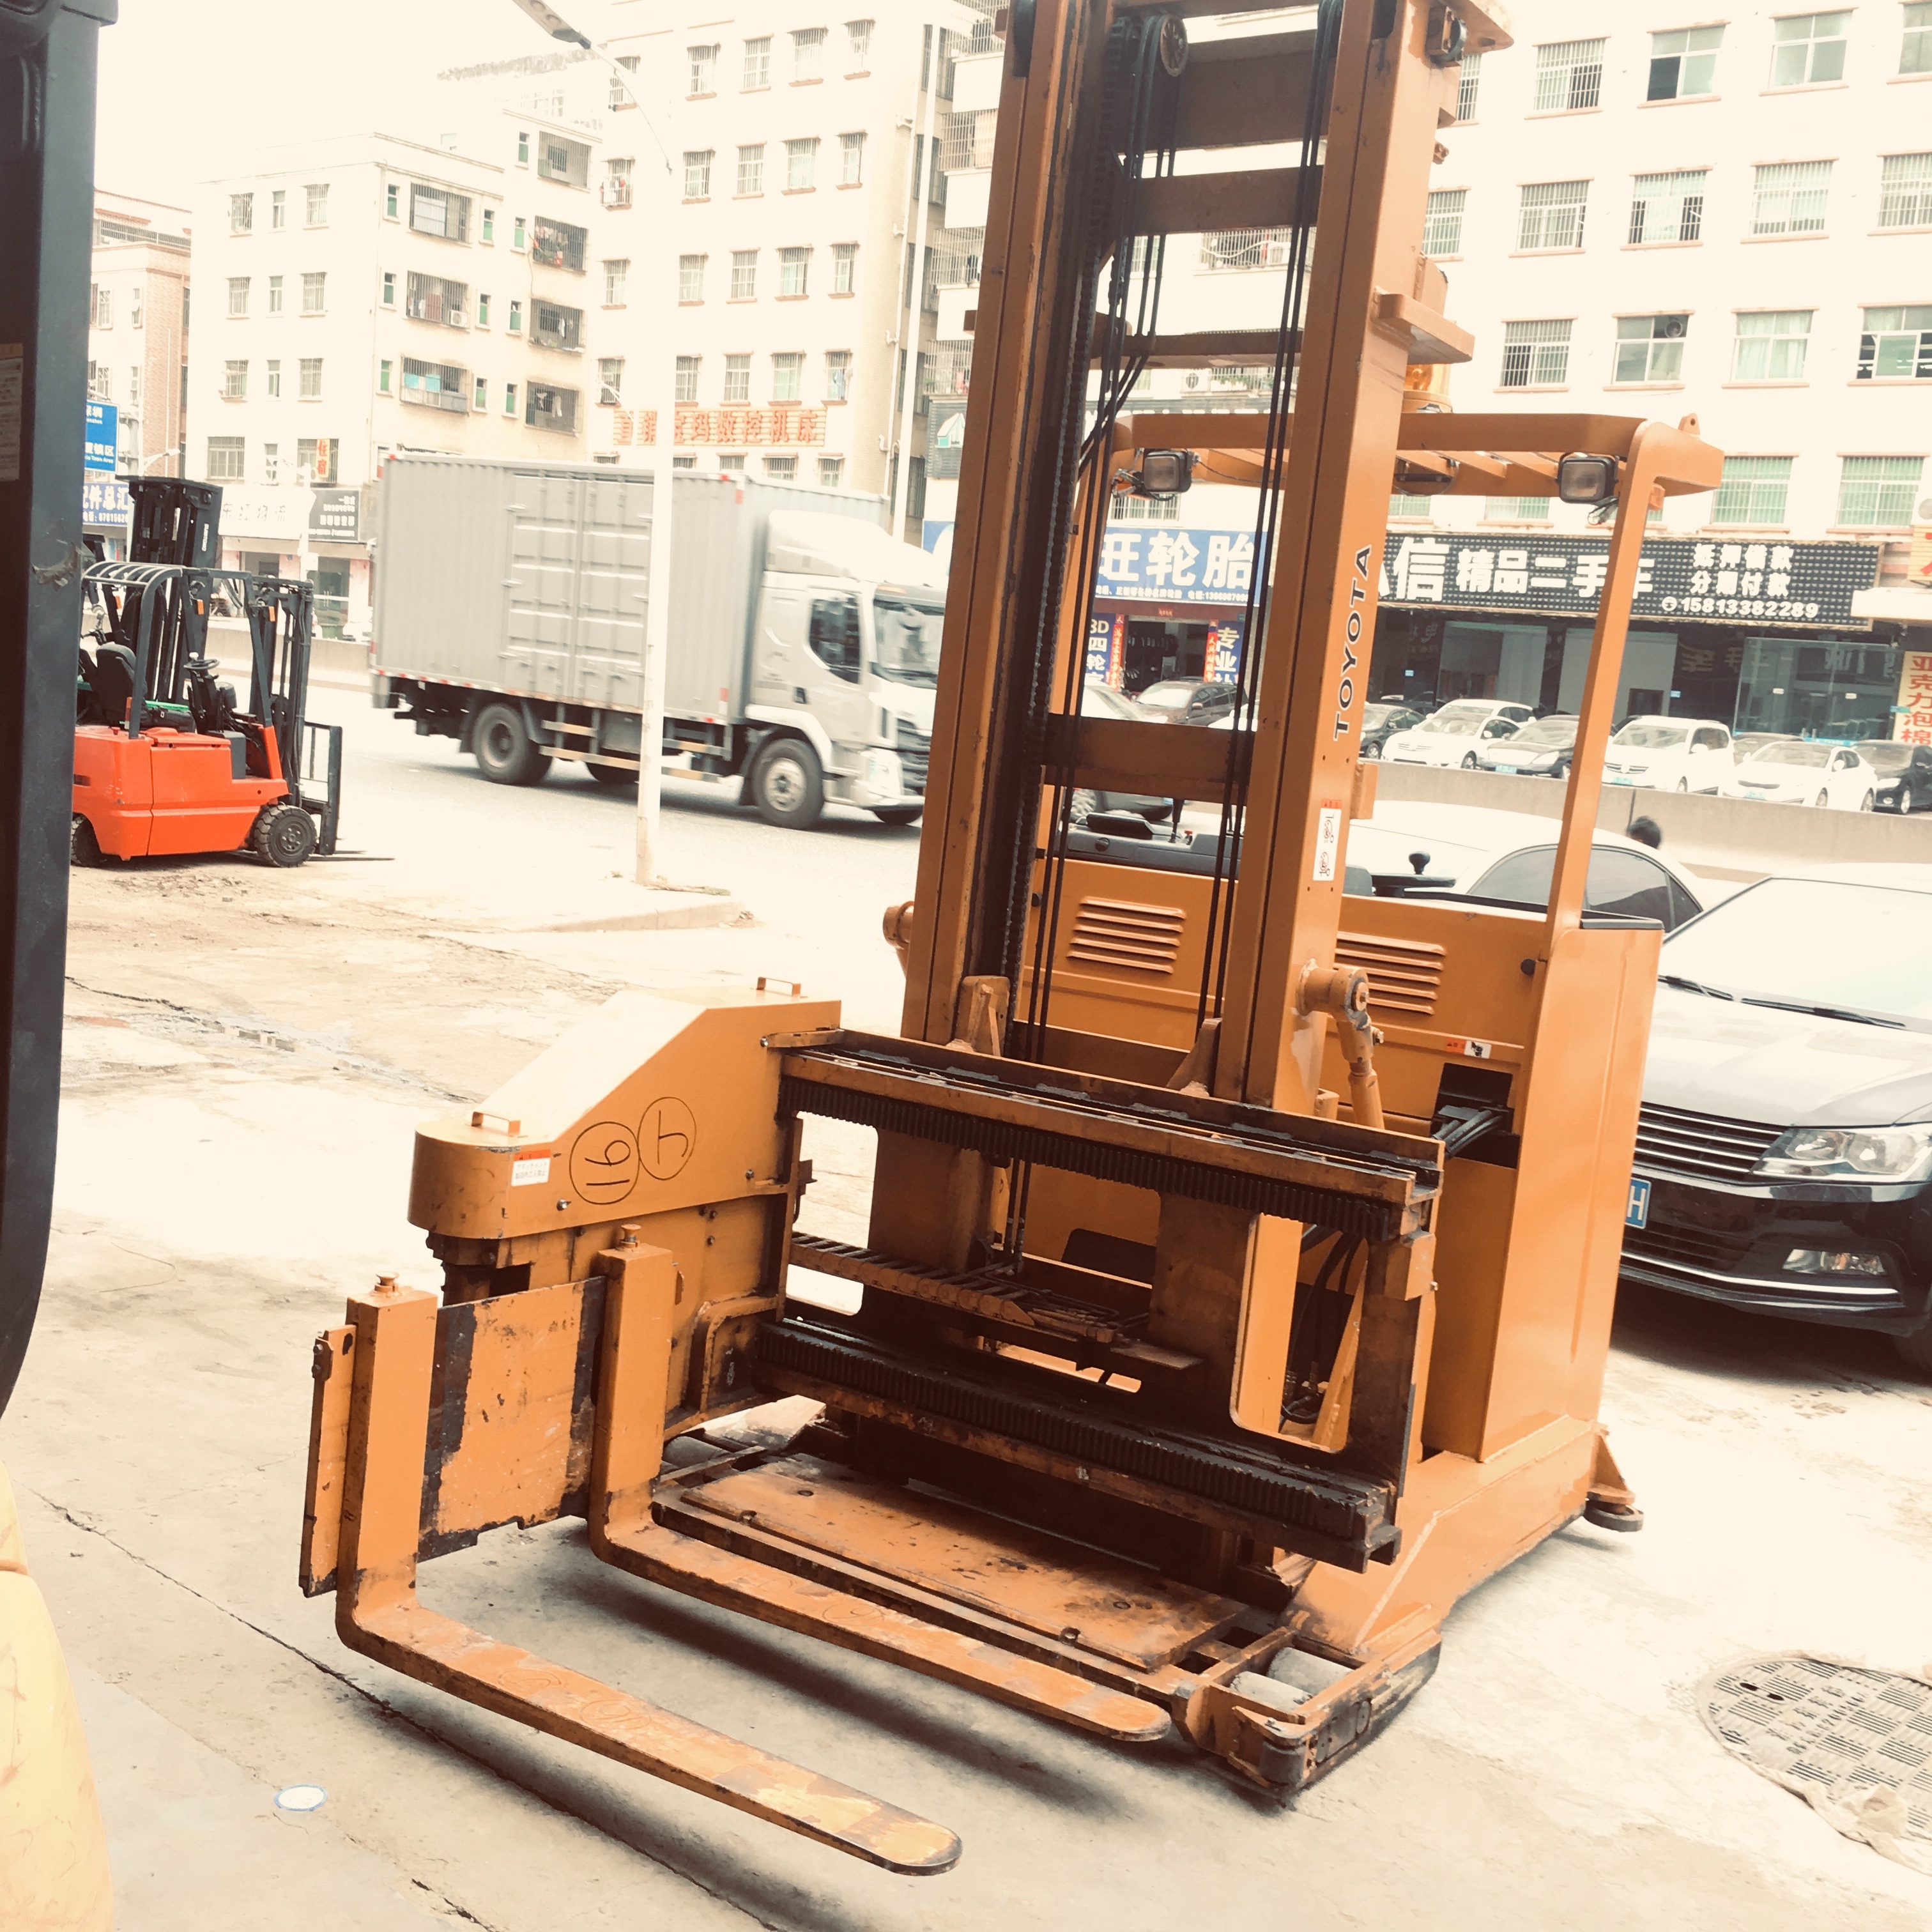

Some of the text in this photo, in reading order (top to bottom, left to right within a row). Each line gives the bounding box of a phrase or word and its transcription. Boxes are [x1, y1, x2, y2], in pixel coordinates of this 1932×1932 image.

[317, 439, 328, 474] 住宿
[1690, 571, 1791, 597] 分期付款
[1681, 597, 1819, 618] 15813382289
[1333, 544, 1372, 741] TOYOTA
